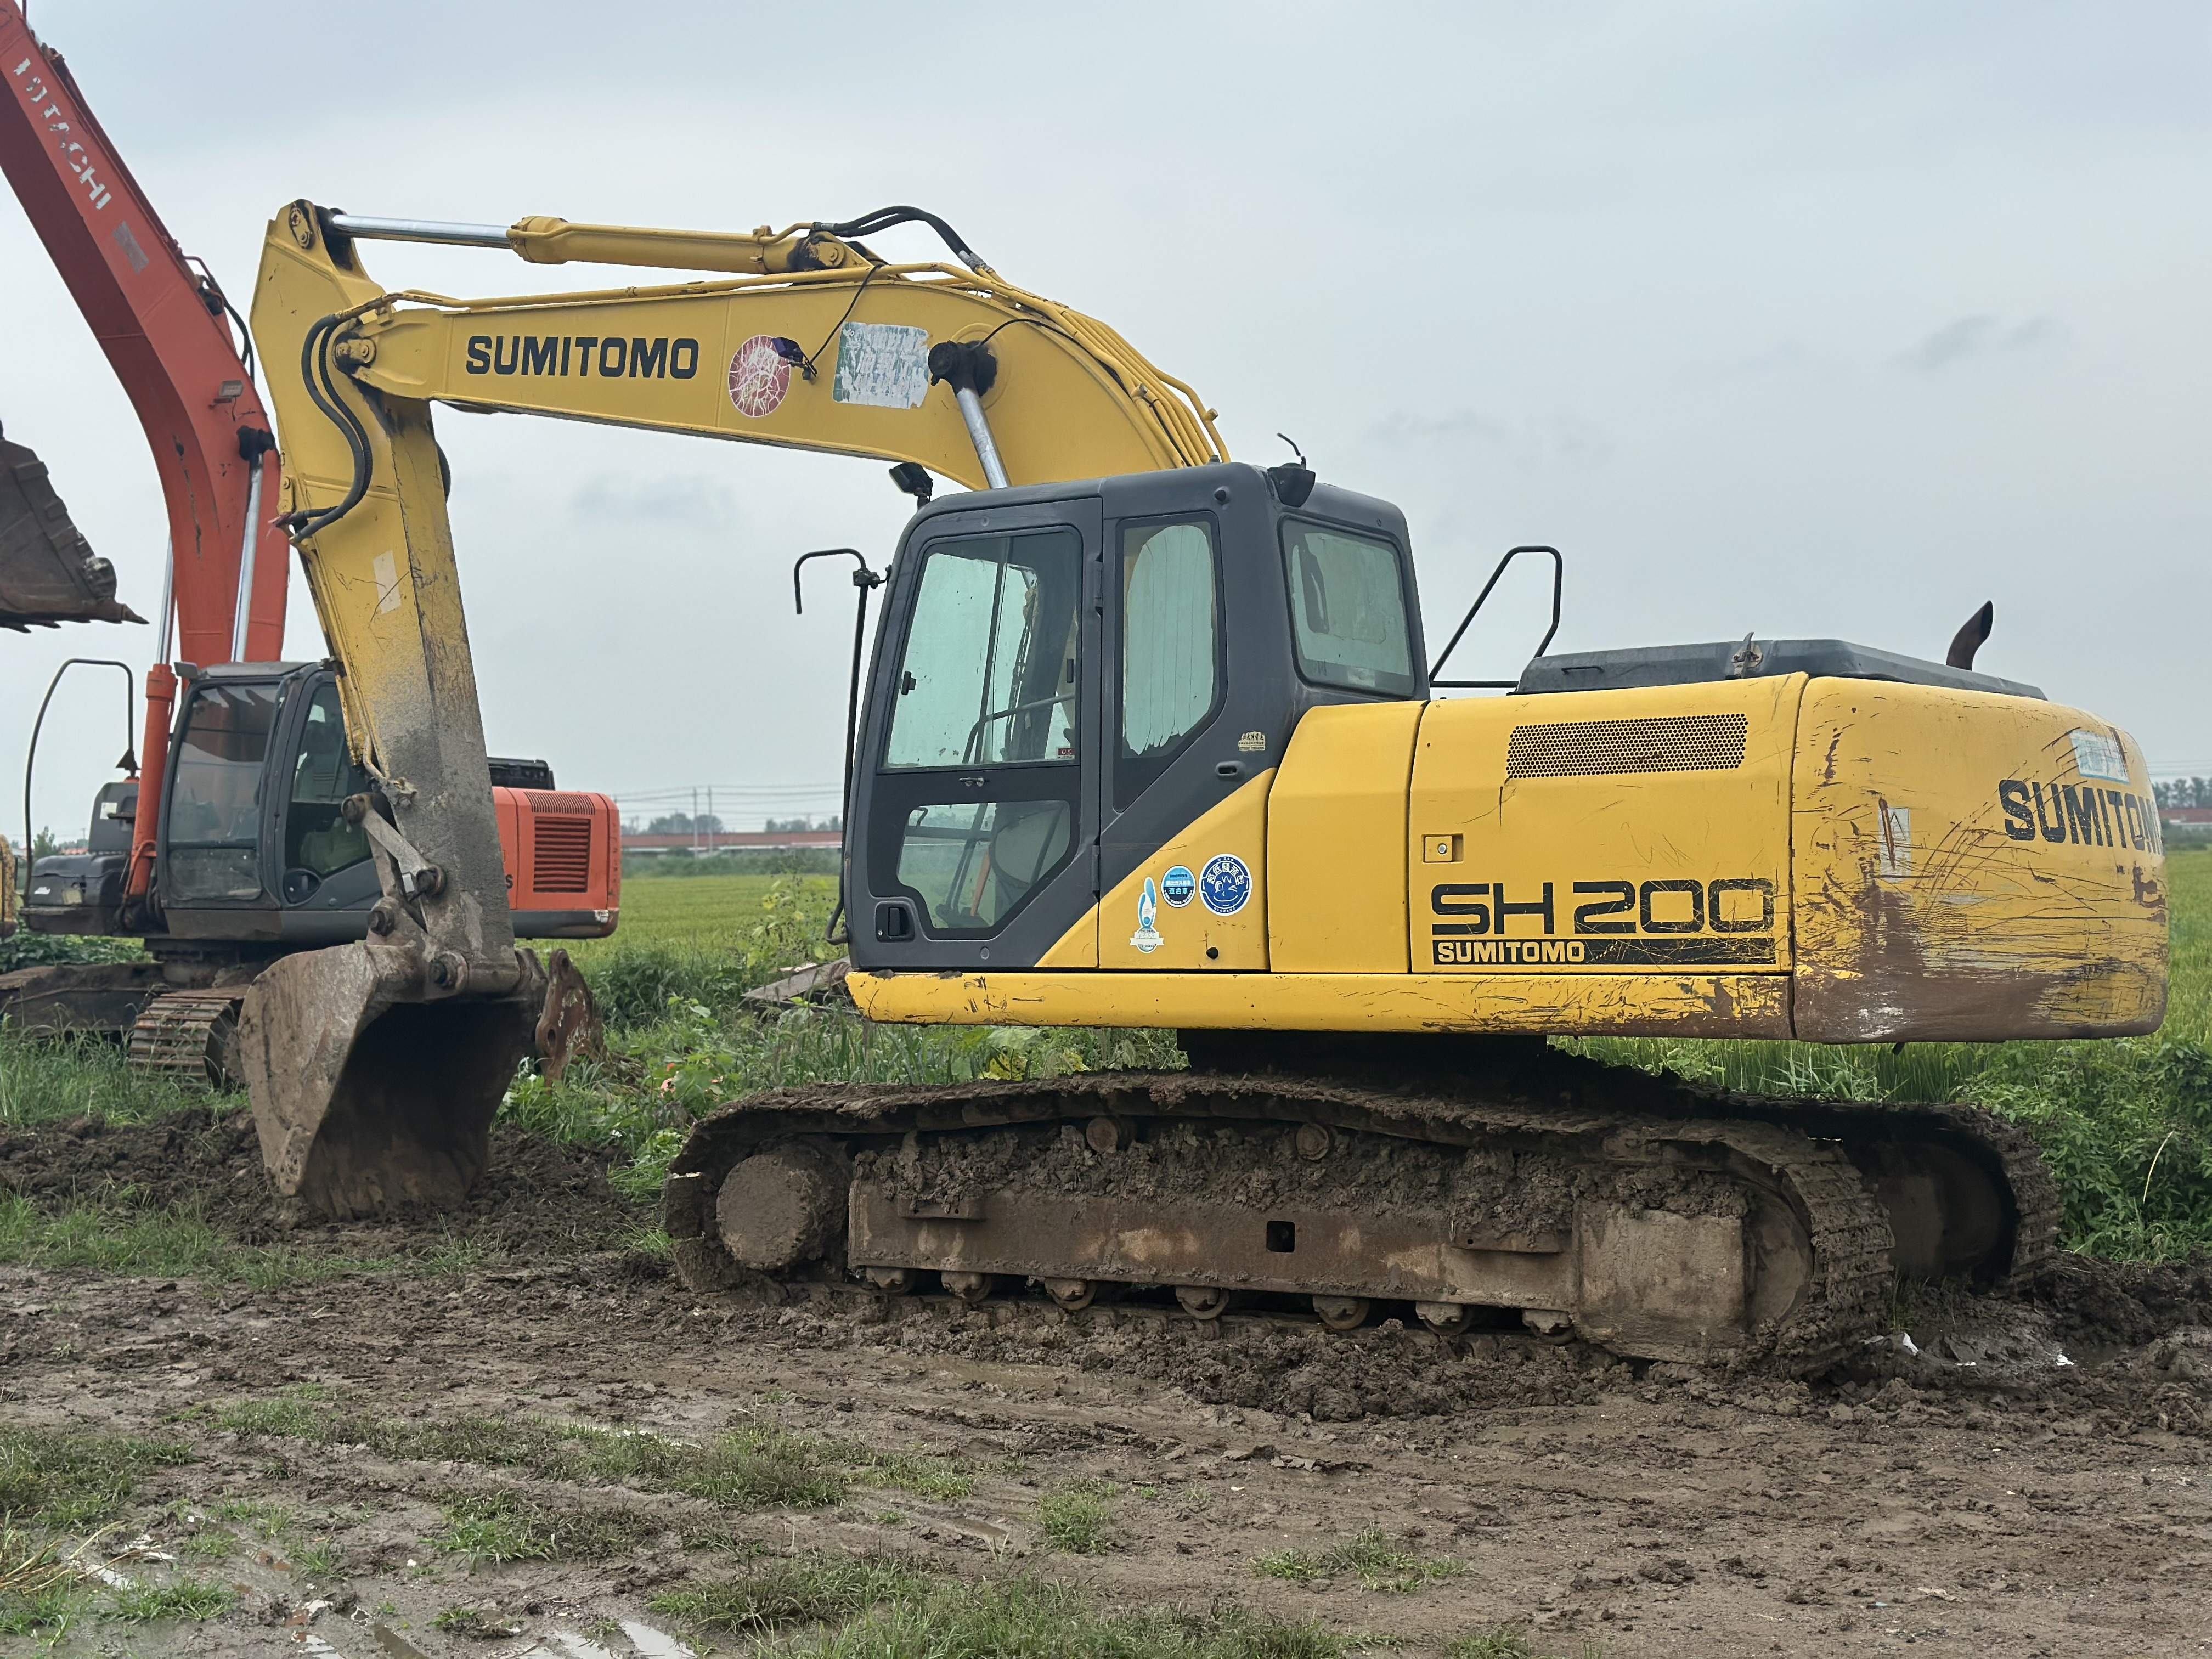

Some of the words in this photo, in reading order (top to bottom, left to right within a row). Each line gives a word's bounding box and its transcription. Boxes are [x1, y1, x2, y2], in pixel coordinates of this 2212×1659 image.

[466, 335, 699, 379] SUMITOMO
[1999, 779, 2163, 856] SUMITOM
[1438, 941, 1585, 963] SUMITOMO
